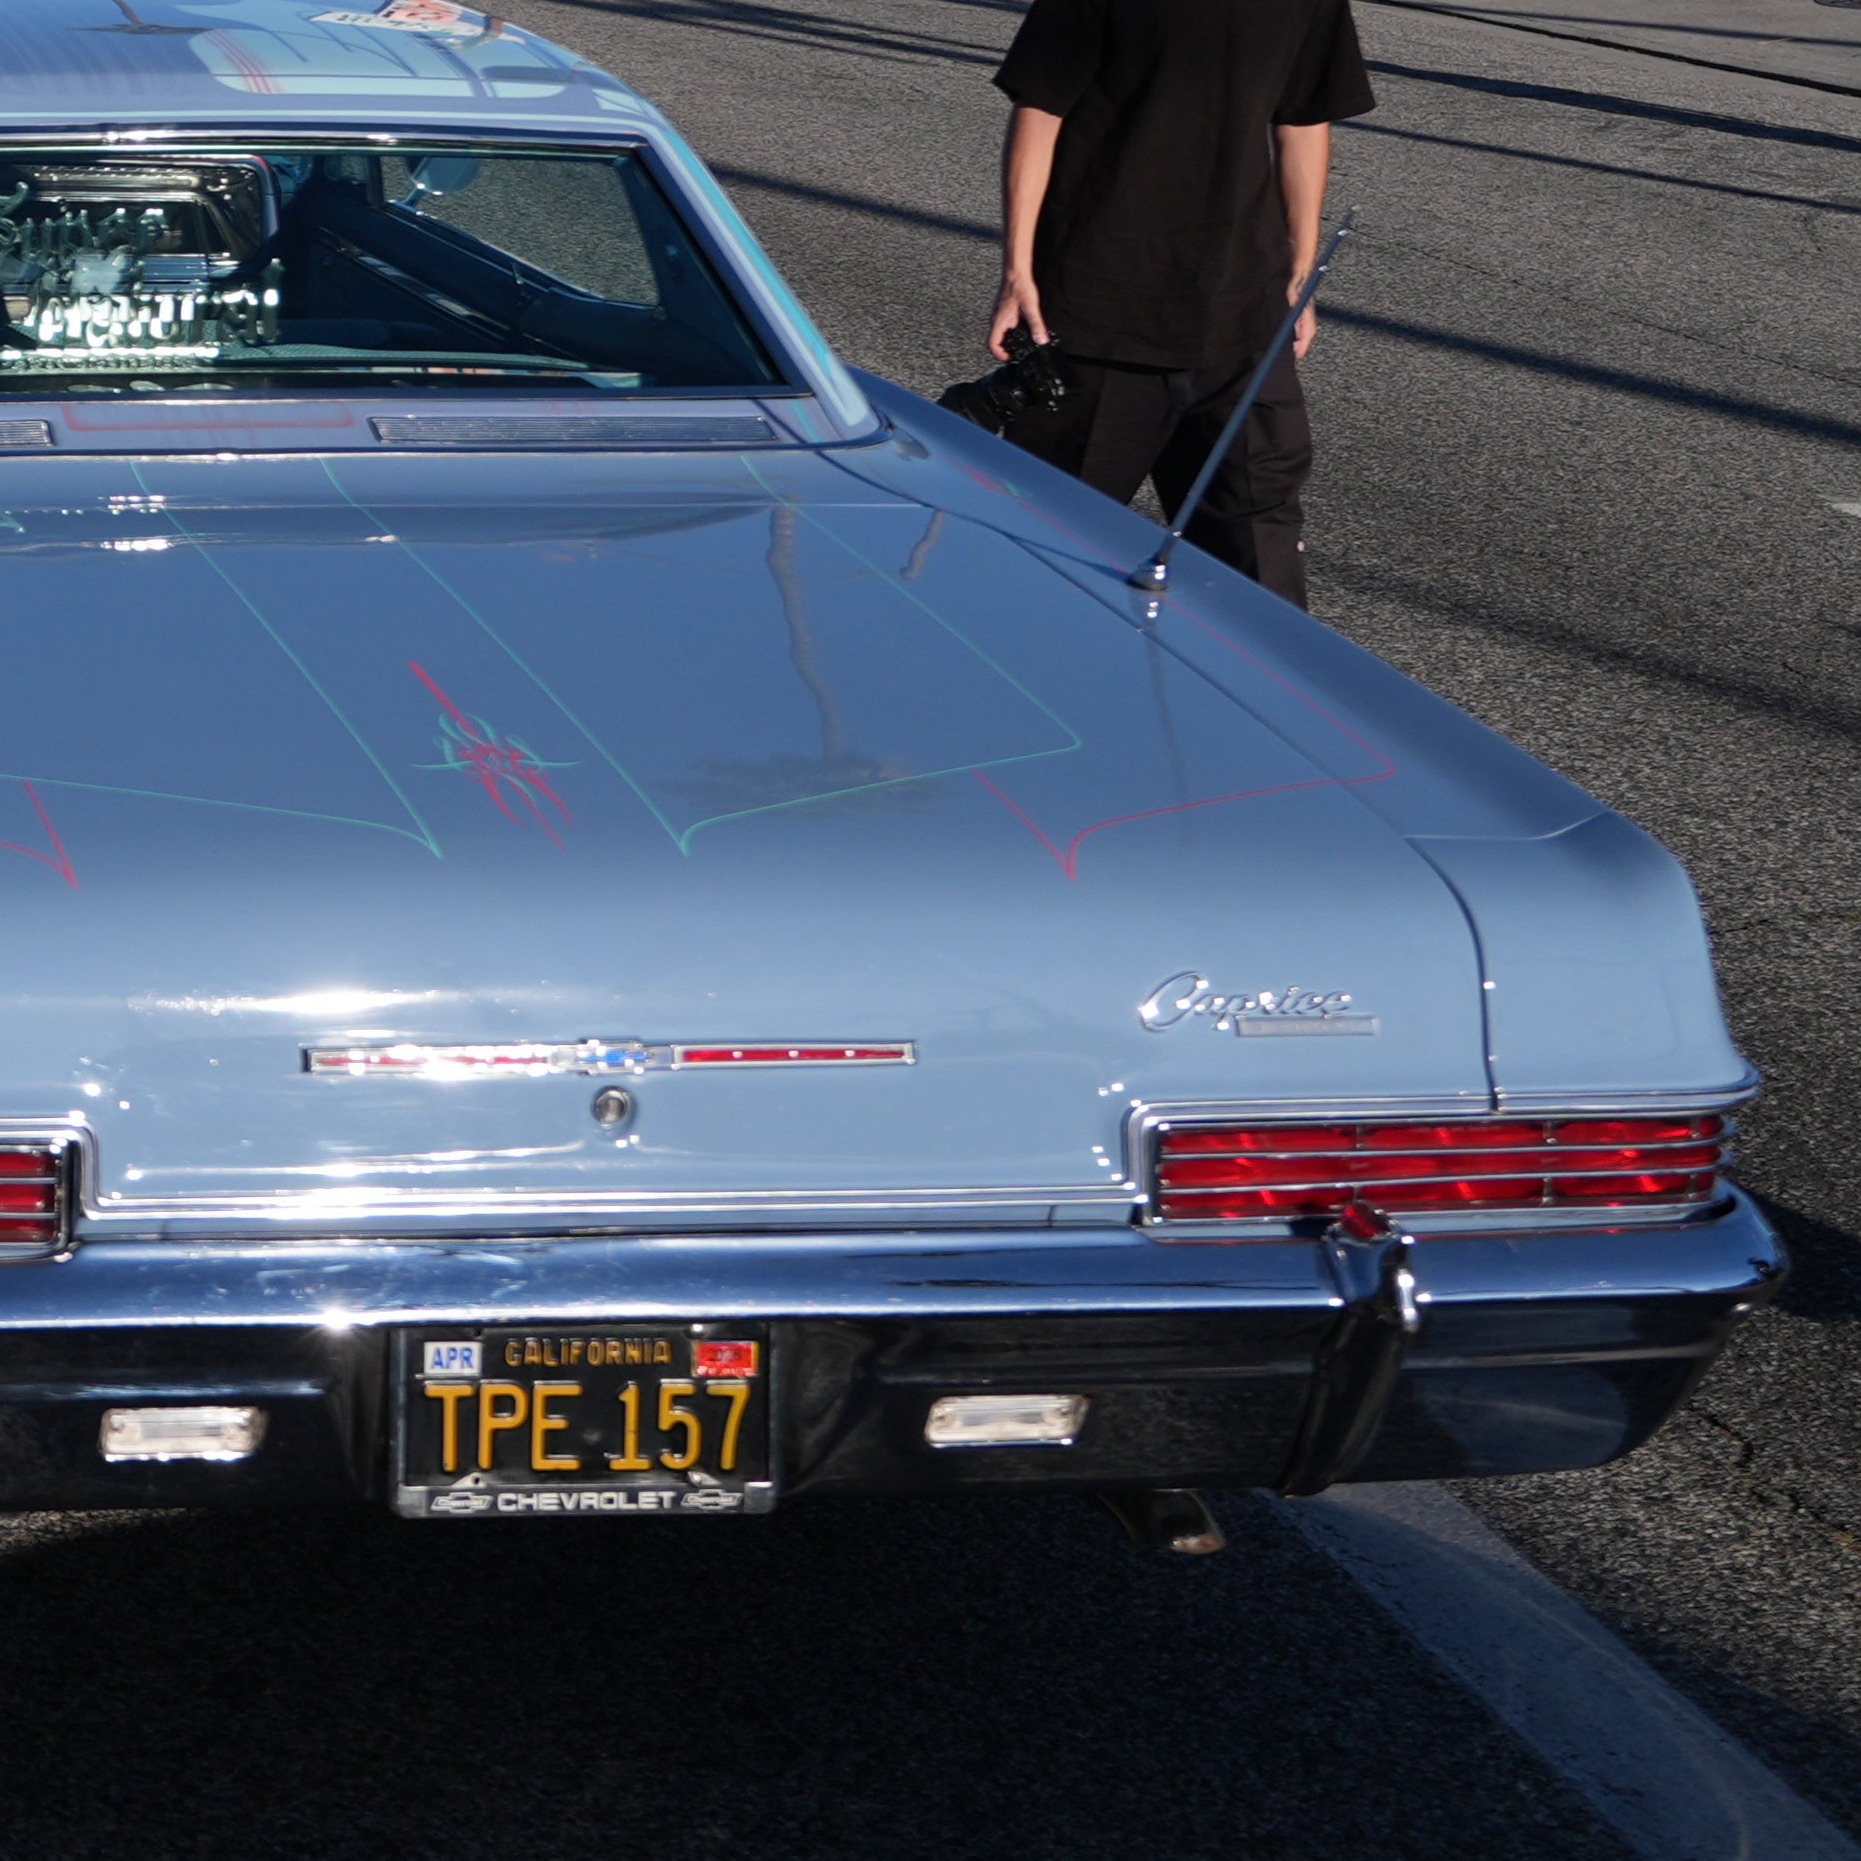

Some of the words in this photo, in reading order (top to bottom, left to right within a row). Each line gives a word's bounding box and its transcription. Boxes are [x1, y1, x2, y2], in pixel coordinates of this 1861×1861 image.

[1142, 971, 1353, 1032] Caprice
[430, 1346, 474, 1370] APR
[505, 1337, 672, 1368] CALIFORNIA
[424, 1379, 581, 1472] TPE
[609, 1379, 750, 1472] 157
[497, 1491, 677, 1512] CHEVROLET
